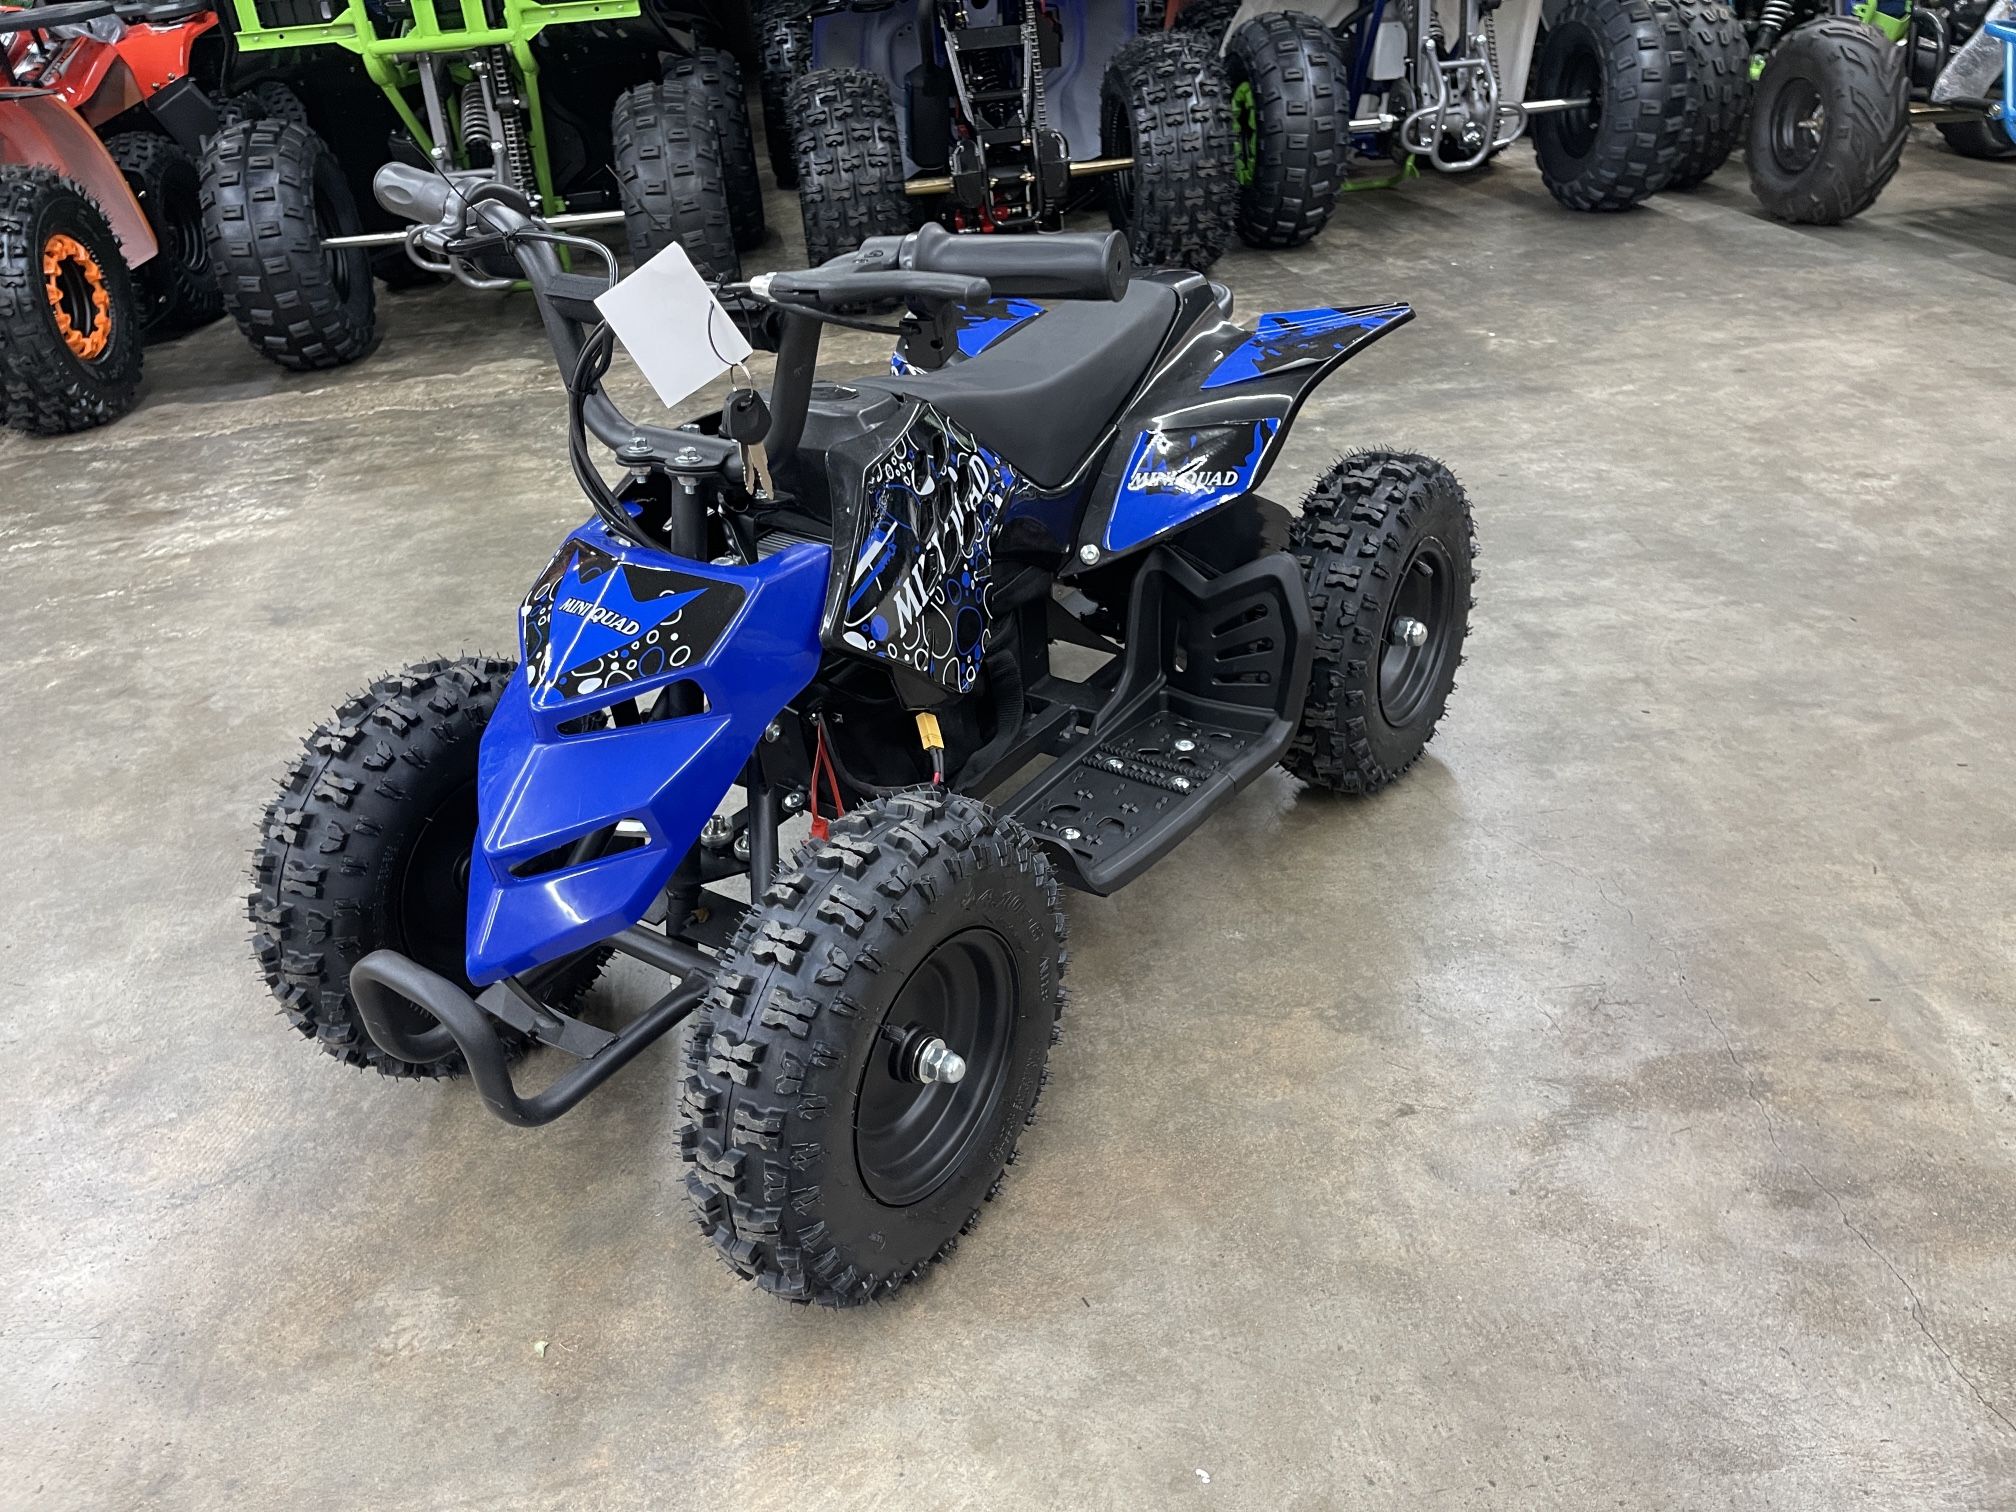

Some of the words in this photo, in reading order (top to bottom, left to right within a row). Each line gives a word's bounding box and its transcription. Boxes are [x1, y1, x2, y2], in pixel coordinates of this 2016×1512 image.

[894, 531, 947, 638] MII
[945, 454, 990, 546] AD
[558, 597, 593, 619] MINI
[592, 605, 640, 636] QUAD
